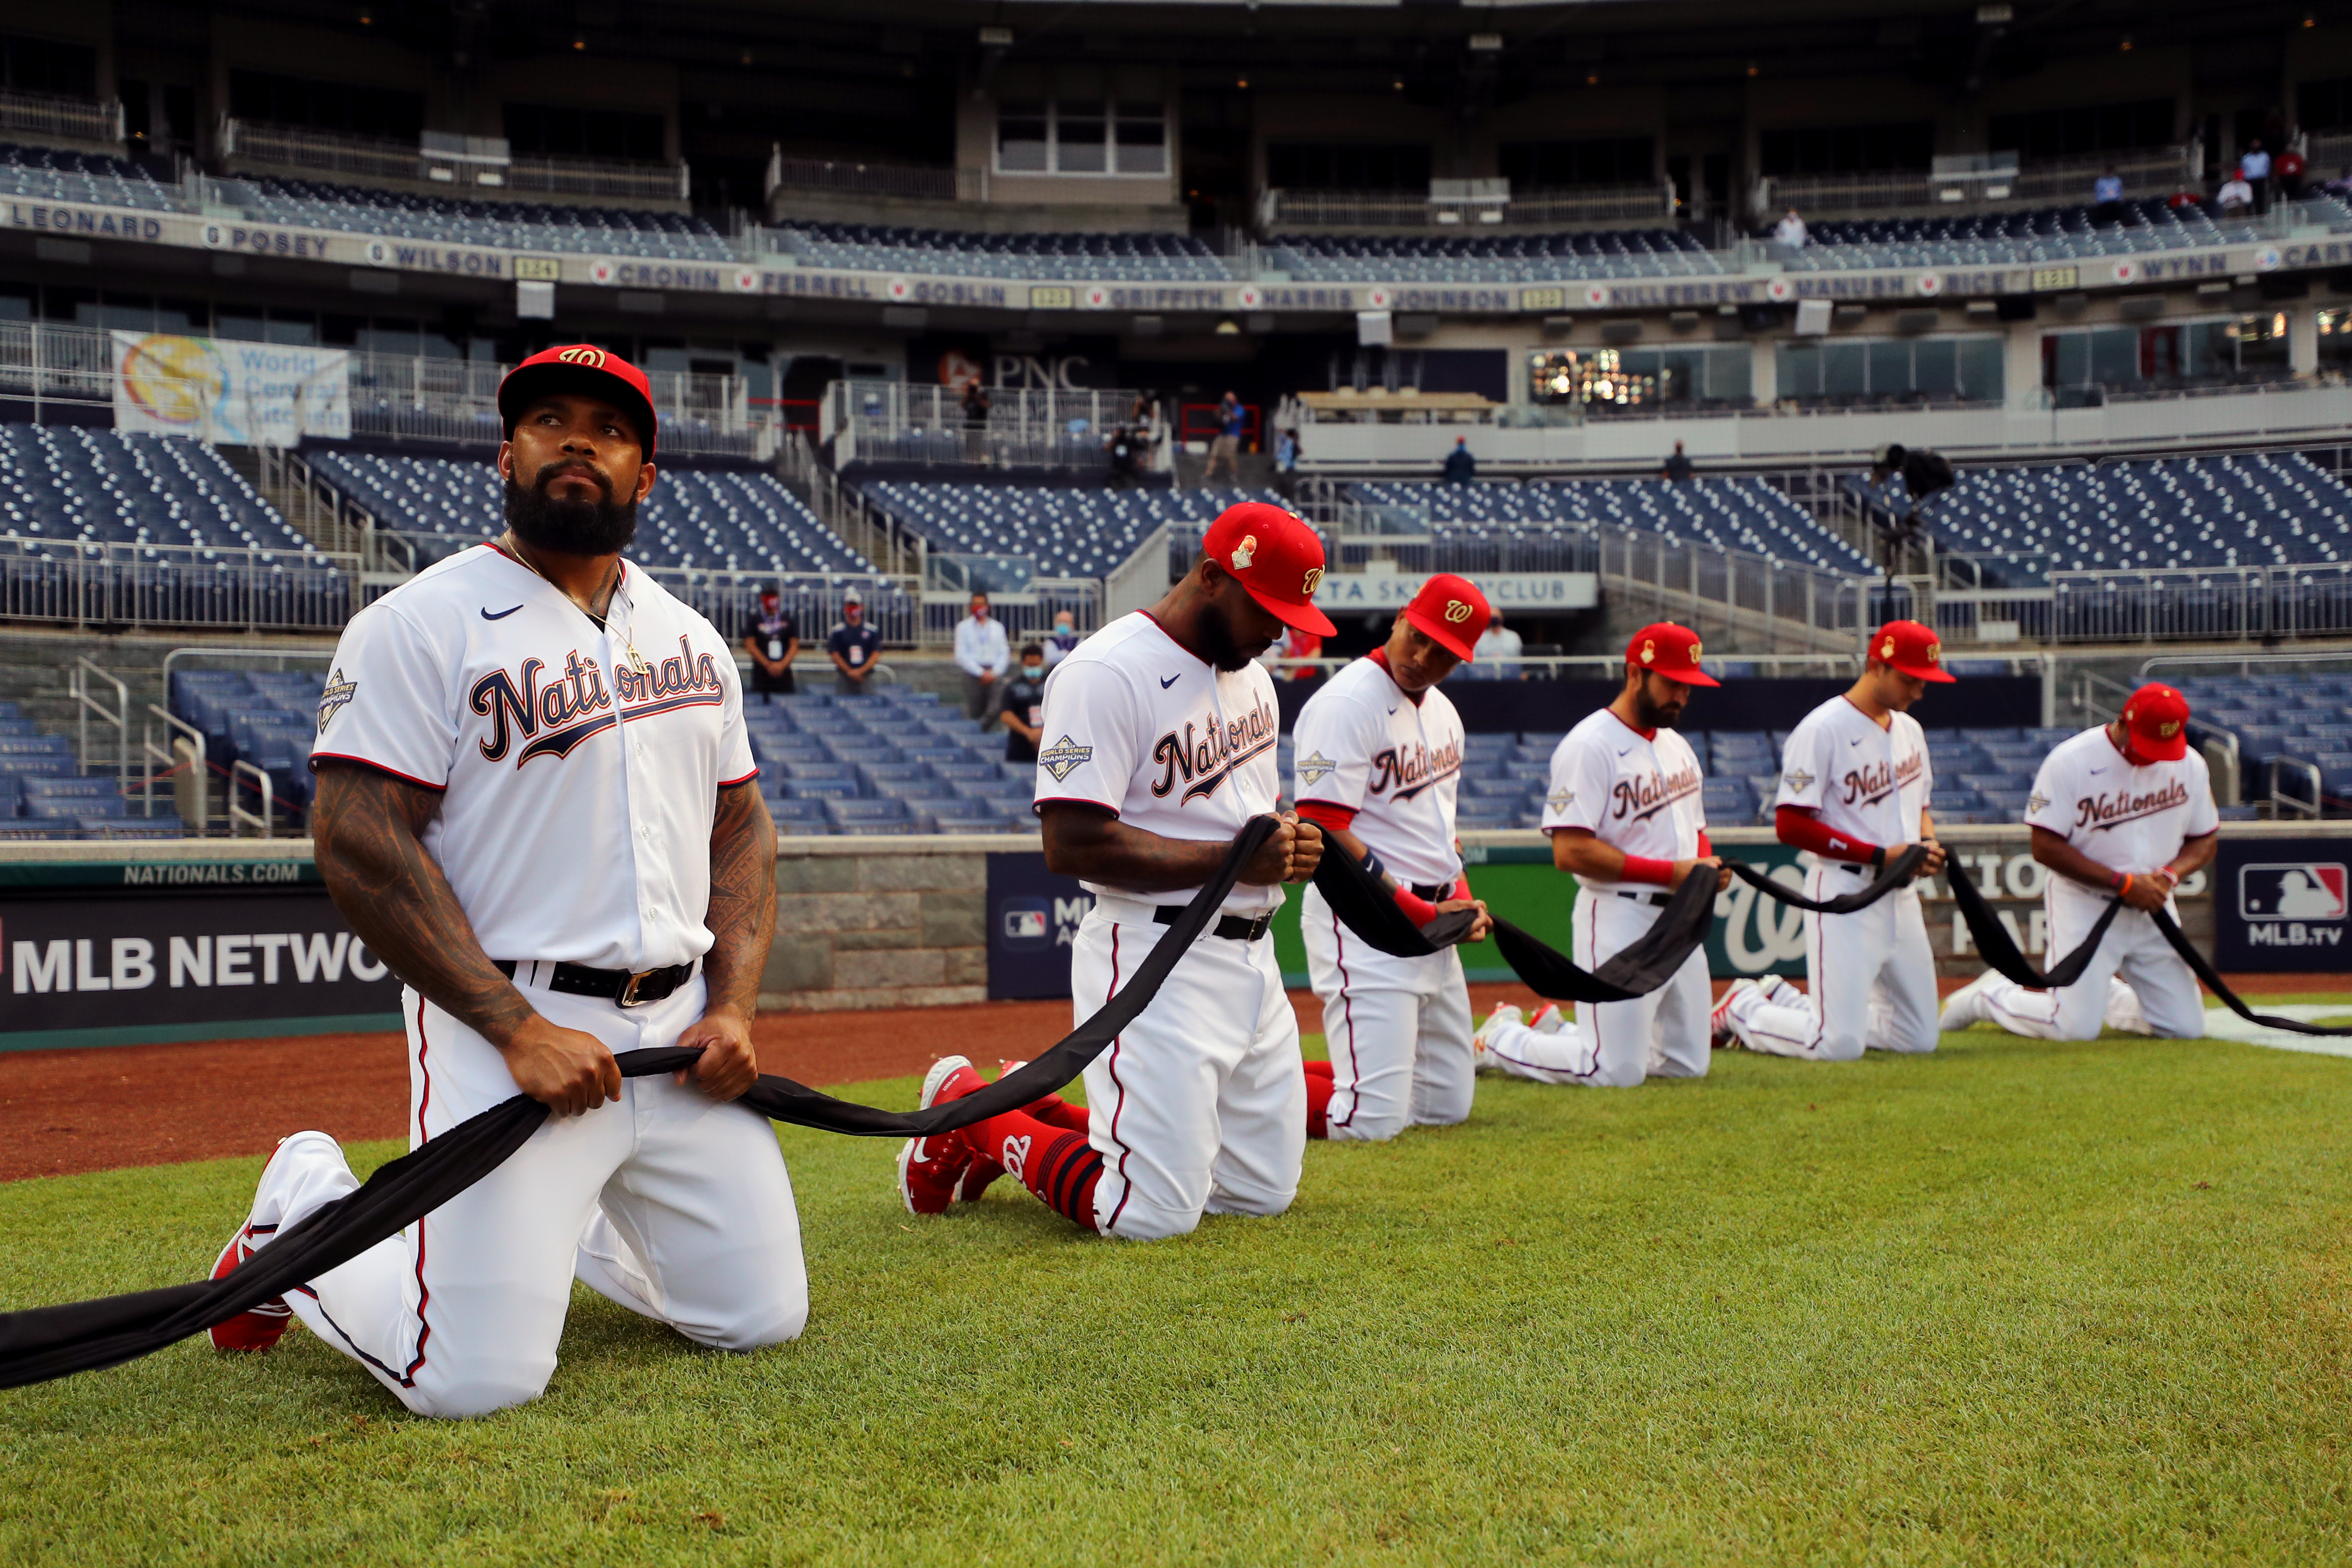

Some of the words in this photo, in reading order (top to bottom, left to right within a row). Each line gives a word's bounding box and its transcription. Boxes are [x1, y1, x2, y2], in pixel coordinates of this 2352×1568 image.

[12, 205, 161, 239] LEONARD
[232, 228, 328, 256] POSEY
[2282, 241, 2352, 266] CAR
[396, 245, 501, 274] WILSON
[2143, 253, 2227, 276] WYNN
[618, 262, 720, 287] CRONIN
[1393, 289, 1509, 308] JOHNSON
[239, 349, 316, 374] World
[993, 355, 1089, 392] PNC
[1497, 580, 1565, 600] CLUB
[1444, 600, 1473, 624] W
[469, 633, 725, 763] Nationals
[1042, 749, 1064, 757] WORLD
[1151, 687, 1275, 799] Nationals
[1040, 753, 1090, 764] CHAMPIONS
[2077, 776, 2188, 828] Nationals
[124, 864, 300, 885] NATIONALS.COM
[2248, 922, 2343, 946] MLB.TV
[12, 937, 157, 995] MLB
[169, 932, 390, 988] NETWO
